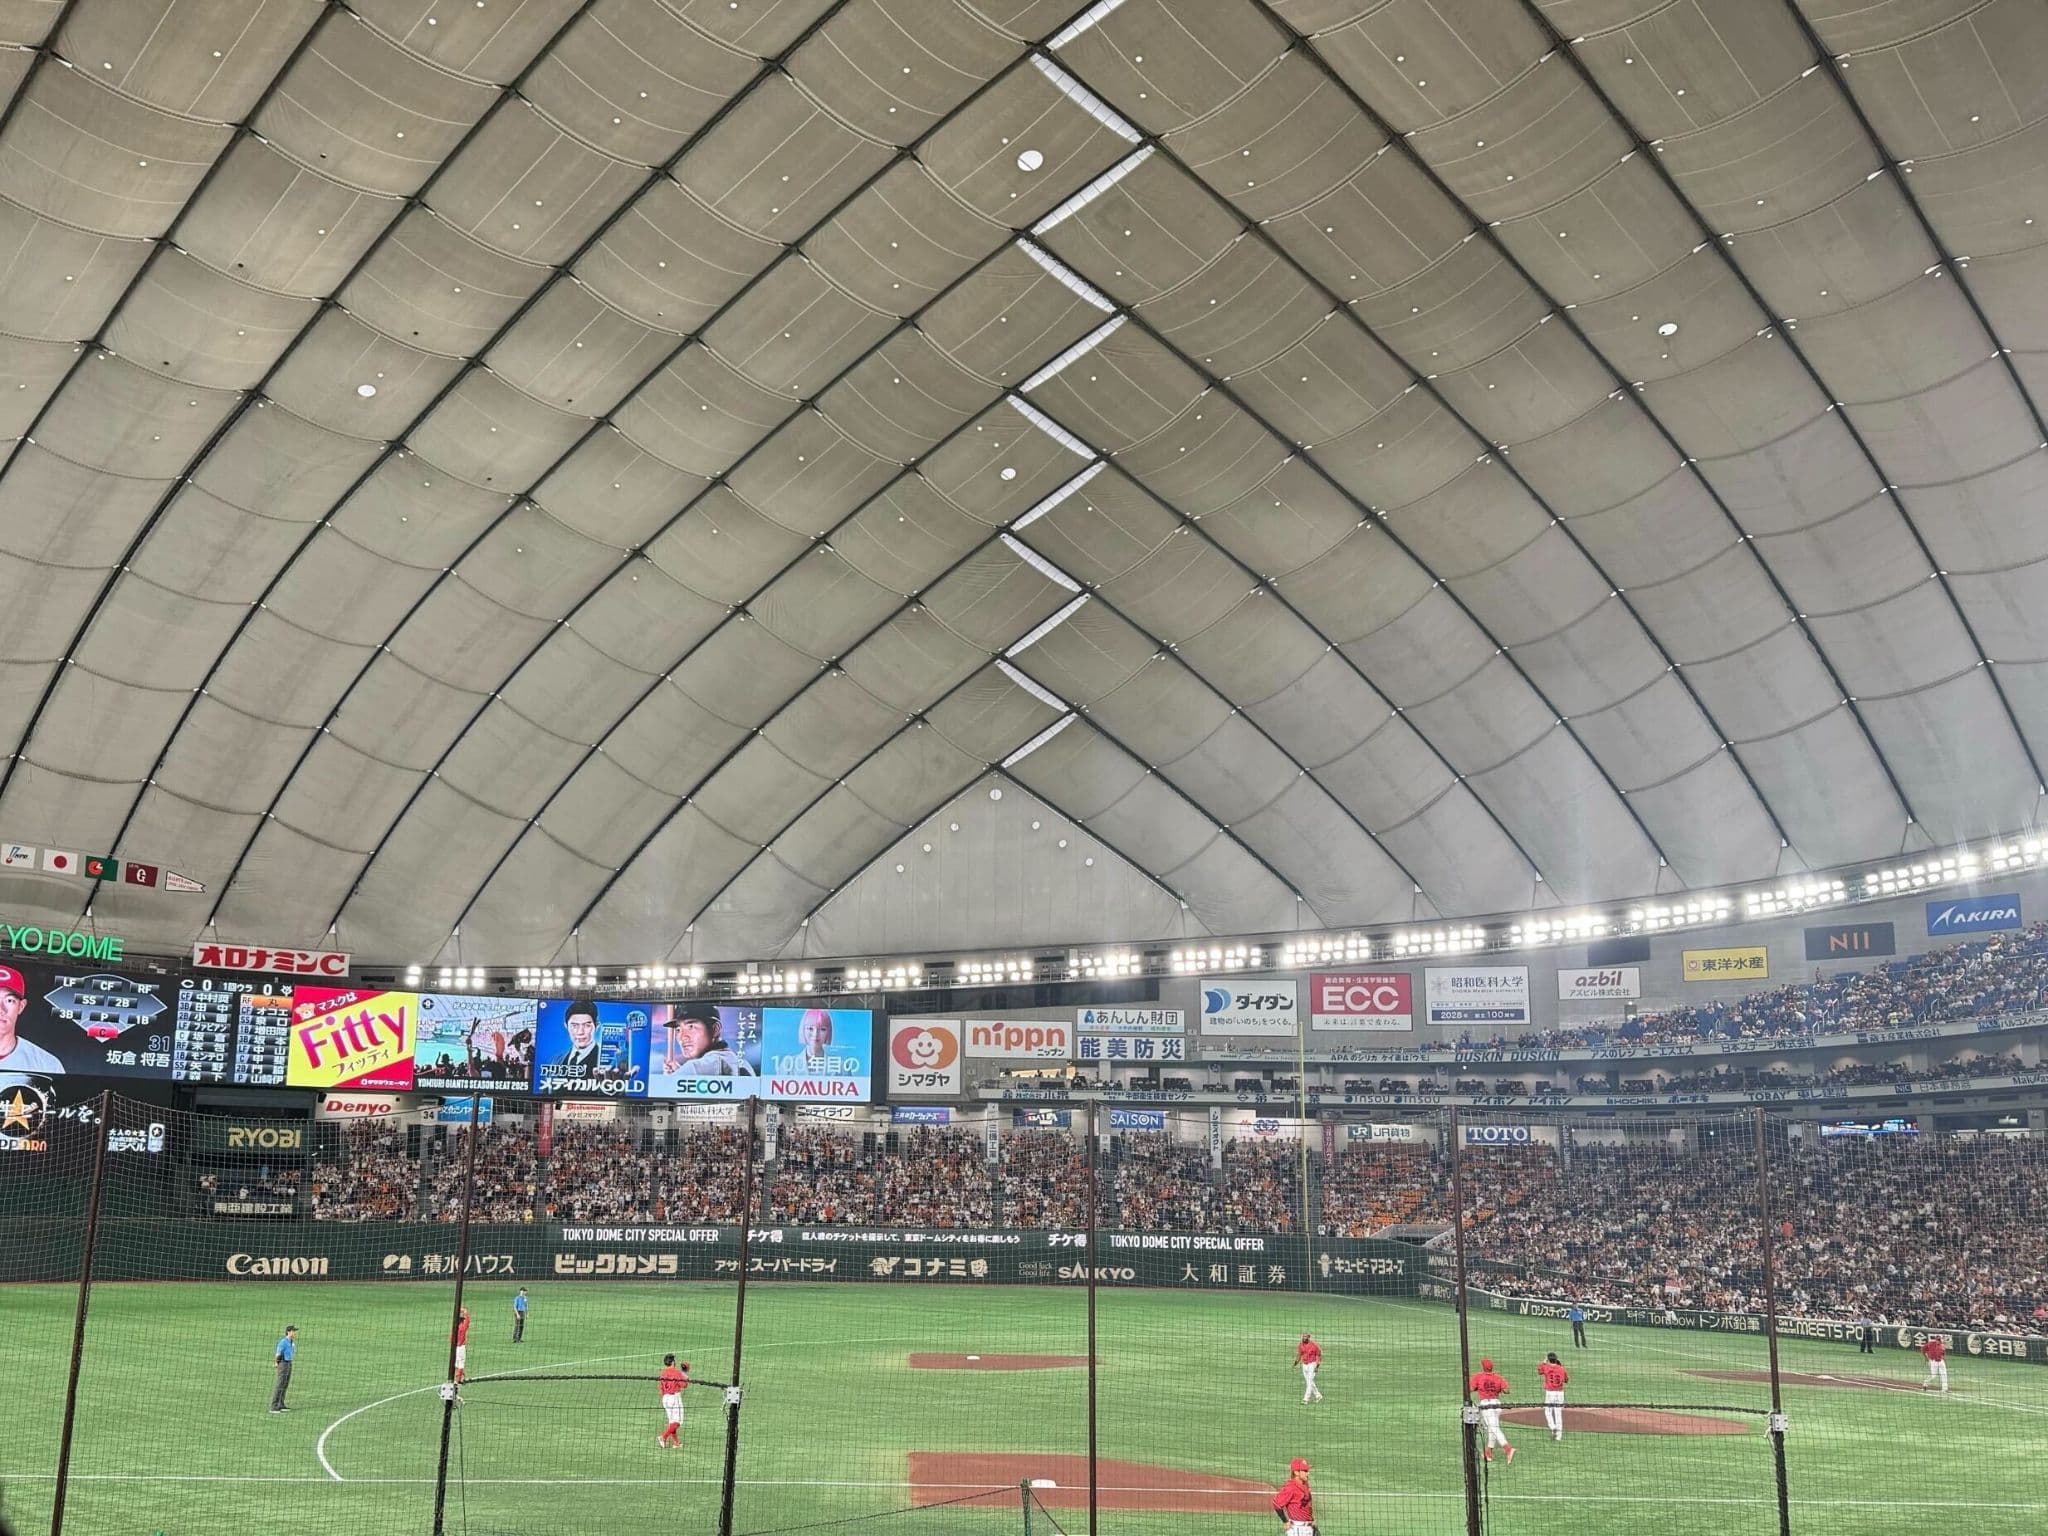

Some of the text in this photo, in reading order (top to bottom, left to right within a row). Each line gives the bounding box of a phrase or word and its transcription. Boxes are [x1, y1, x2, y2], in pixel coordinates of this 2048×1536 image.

[1953, 908, 2018, 924] AKIRA
[47, 930, 124, 962] DOME
[197, 945, 345, 975] オロナミンC
[1702, 956, 1765, 972] 東洋水産
[63, 977, 76, 987] LF
[100, 981, 114, 991] CF
[203, 979, 212, 991] 0
[1451, 976, 1523, 988] 昭和医科大学
[1575, 970, 1623, 987] azbil
[137, 984, 152, 994] RF
[223, 982, 253, 992] 1回ウラ
[263, 983, 273, 996] 0
[82, 996, 96, 1005] SS
[115, 998, 130, 1008] 2B
[317, 992, 357, 1011] マスクは
[1235, 993, 1293, 1010] ダイダン
[1322, 985, 1399, 1011] ECC
[59, 1009, 74, 1019] 3B
[100, 1013, 109, 1021] P
[136, 1015, 150, 1025] 1B
[1096, 1010, 1178, 1025] あんしん財団
[148, 1035, 170, 1052] 31
[299, 1006, 405, 1068] Fitty
[972, 1022, 1065, 1051] nippn
[1080, 1037, 1182, 1059] 能美防災
[106, 1050, 171, 1067] 坂倉 将吾
[332, 1049, 389, 1076] フィッティ
[1455, 1050, 1560, 1062] DUSKIN DUSKIN
[540, 1064, 586, 1077] アリナミン
[771, 1055, 859, 1073] 100年目の
[418, 1078, 528, 1090] YOMIURI GIANTS SEASON SEAT 2025
[677, 1080, 732, 1093] SECOM
[898, 1073, 950, 1087] シマダヤ
[771, 1080, 858, 1096] NOMURA
[326, 1101, 391, 1115] Denyo
[424, 1111, 434, 1119] 34
[657, 1116, 663, 1124] 3
[1110, 1114, 1159, 1126] SAISON
[228, 1128, 301, 1148] RYOBI
[1353, 1127, 1369, 1135] JR
[1469, 1127, 1528, 1141] TOTO
[563, 1229, 718, 1241] TOKYO DOME CITY SPECIAL OFFER
[748, 1230, 782, 1243] チケ得
[1049, 1234, 1087, 1247] チケ得
[1110, 1235, 1264, 1250] TOKYO DOME CITY SPECIAL OFFER
[226, 1254, 328, 1275] Canon
[423, 1255, 515, 1273] 積水ハウス
[555, 1254, 678, 1274] ビックカメラ
[904, 1258, 967, 1277] コナミ
[1180, 1263, 1286, 1284] 大和証券
[1699, 1314, 1760, 1331] トンボ鉛筆
[1796, 1321, 1882, 1342] MEETS POT
[1913, 1332, 1952, 1350] 全警
[1984, 1338, 2027, 1357] 全日警
